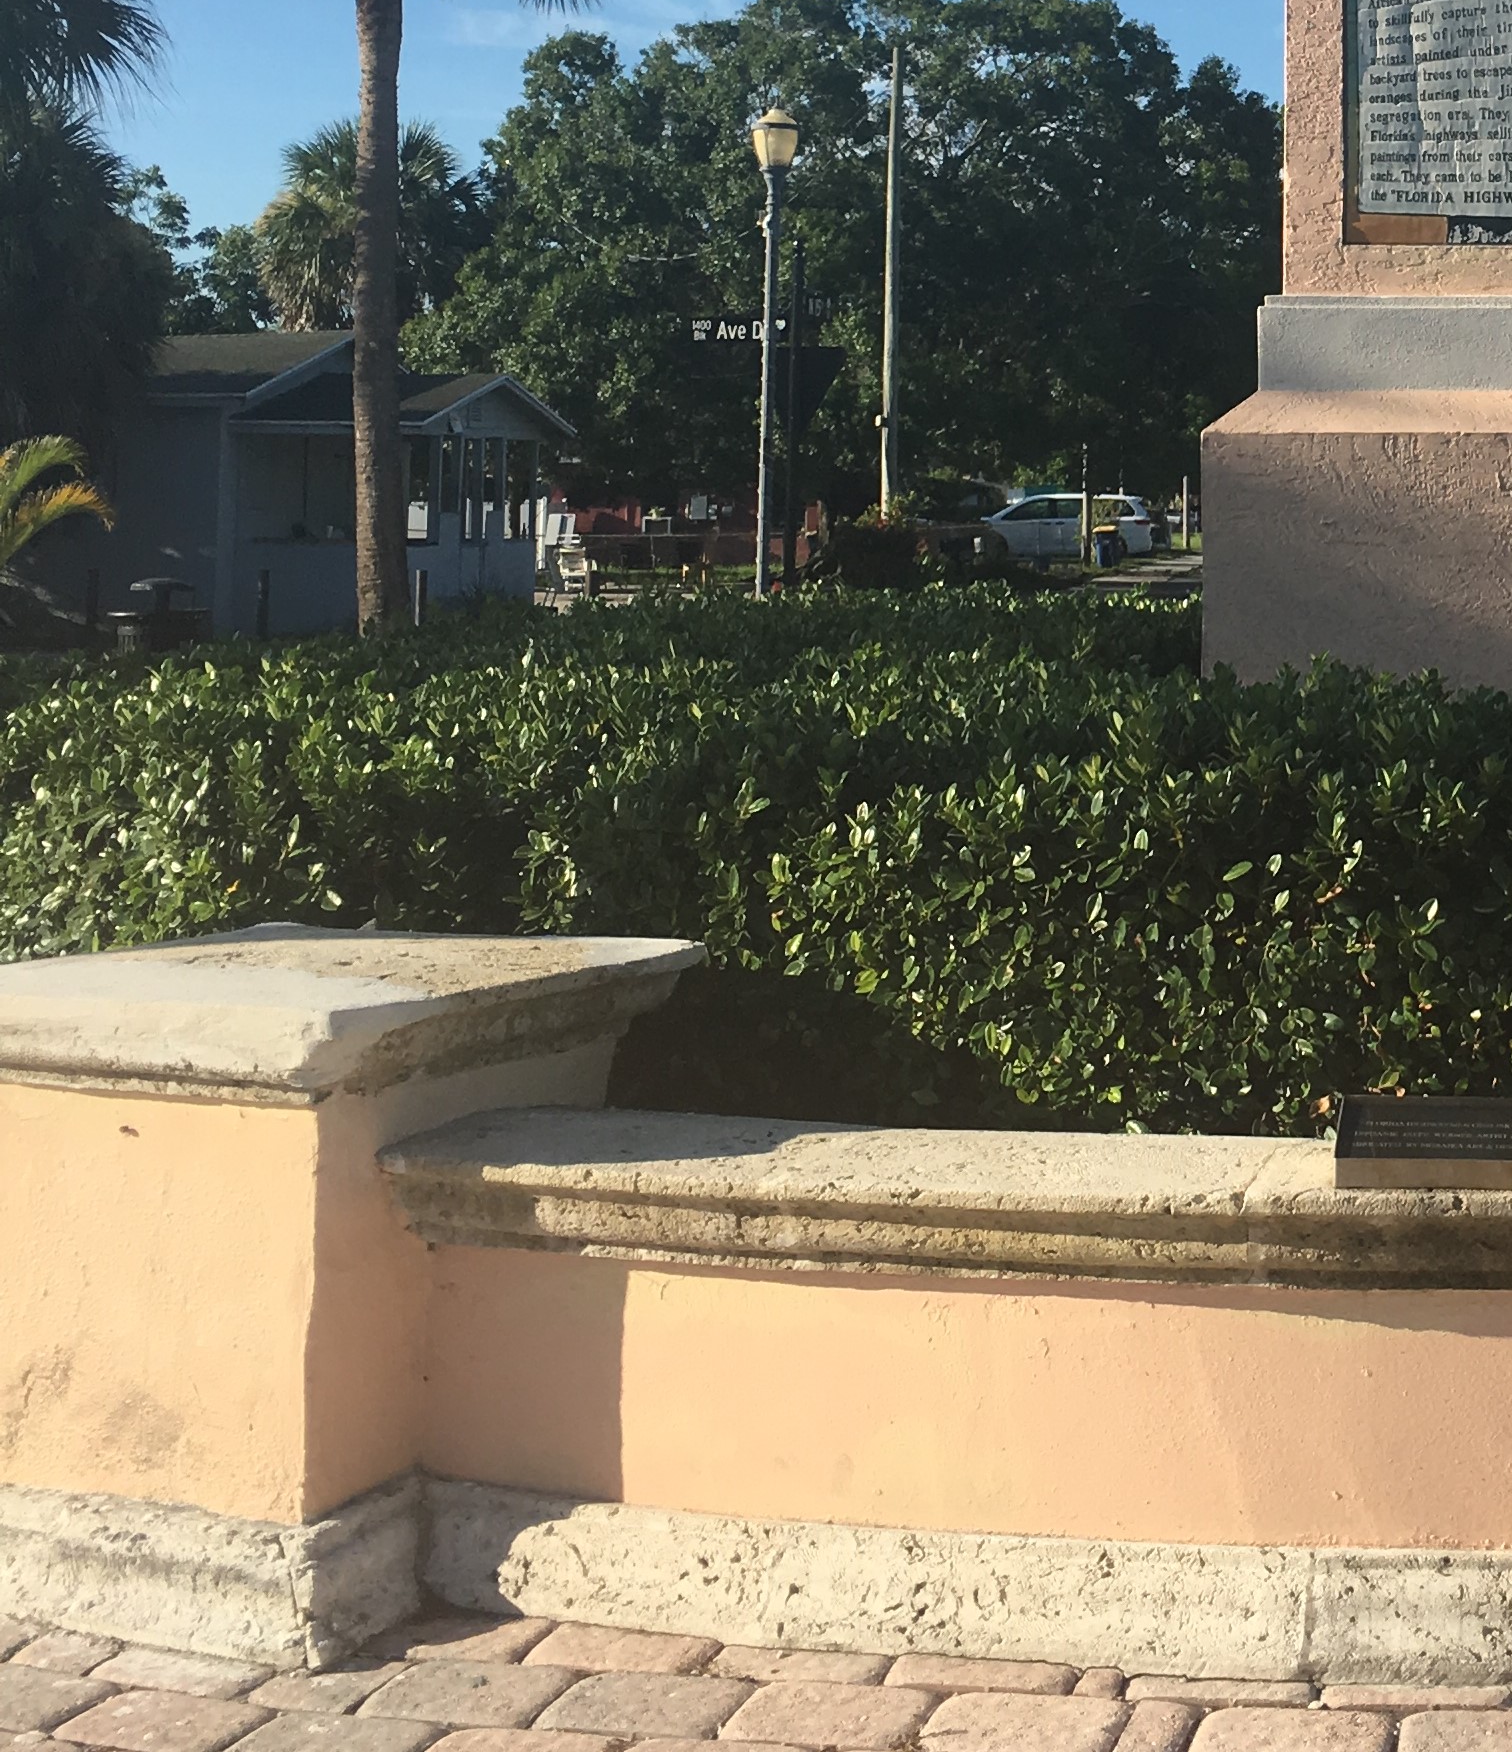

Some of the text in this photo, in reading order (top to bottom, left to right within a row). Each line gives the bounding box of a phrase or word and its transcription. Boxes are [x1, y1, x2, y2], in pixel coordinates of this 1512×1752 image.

[1368, 18, 1378, 28] to
[1386, 10, 1434, 26] skillfully
[1442, 6, 1487, 21] capture
[1433, 28, 1448, 40] of
[1457, 25, 1487, 38] their
[1370, 54, 1406, 66] artists
[1415, 46, 1459, 64] painted
[1470, 44, 1507, 57] under
[1369, 69, 1417, 87] backyard
[1423, 68, 1451, 79] trees
[1457, 66, 1467, 78] to
[1474, 64, 1512, 78] escape
[1369, 93, 1412, 105] oranges
[1420, 88, 1459, 102] during
[1468, 86, 1488, 98] the
[1370, 111, 1441, 124] segregation
[1479, 108, 1509, 122] They
[1370, 130, 1415, 142] Florida's
[1425, 130, 1478, 144] highways
[1370, 151, 1416, 165] paintings
[1422, 150, 1449, 162] from
[1455, 150, 1482, 161] their
[1401, 170, 1429, 184] They
[1435, 174, 1464, 182] came
[1470, 171, 1481, 182] to
[1488, 170, 1501, 182] be
[1370, 191, 1387, 201] the
[692, 320, 711, 330] 1400
[717, 321, 746, 340] Ave
